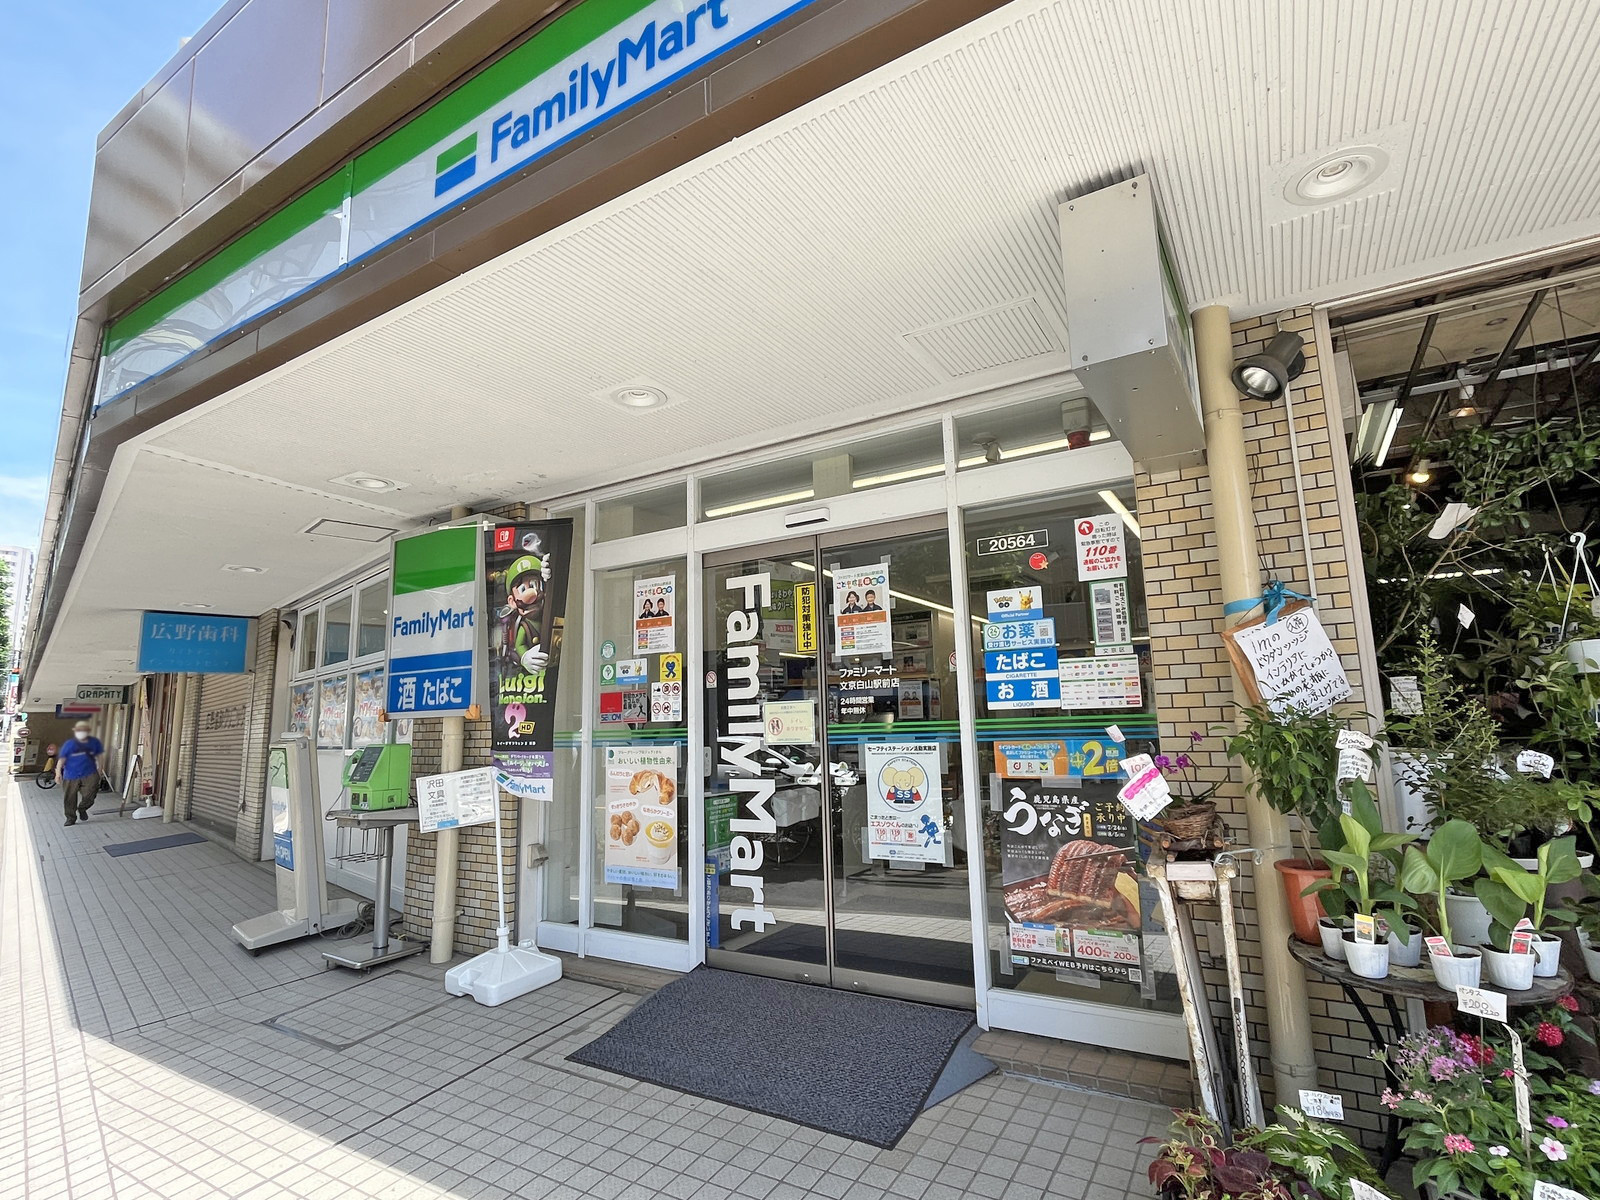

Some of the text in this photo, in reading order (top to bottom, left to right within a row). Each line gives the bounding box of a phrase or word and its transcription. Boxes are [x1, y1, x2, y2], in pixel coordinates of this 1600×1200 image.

[491, 0, 729, 163] FamilyMart
[989, 534, 1036, 552] 20564
[1086, 545, 1117, 557] 110番
[393, 606, 474, 638] FamilyMart
[801, 587, 812, 650] 防犯対策強化中
[151, 622, 239, 643] 広野歯科
[1002, 623, 1035, 639] お薬
[996, 652, 1046, 671] たばこ
[839, 665, 897, 678] ファミリーマート
[839, 678, 899, 690] 文京白山駅前店
[998, 680, 1049, 699] お 酒
[398, 676, 416, 711] 酒
[422, 676, 462, 707] たばこ
[600, 713, 621, 721] SECOM
[841, 706, 867, 715] 年中無休
[505, 703, 526, 739] 2
[720, 572, 777, 933] FamilyMart
[426, 778, 444, 789] 沢田
[427, 789, 445, 800] 文具
[896, 790, 911, 798] SS
[1034, 794, 1080, 804] 鹿児島県産
[1003, 787, 1090, 837] うなぎ
[1095, 802, 1125, 812] ご予約
[1095, 813, 1125, 824] 承り中
[1114, 952, 1131, 960] 200
[1031, 957, 1127, 975] ファミペイWEB予約はこちらから
